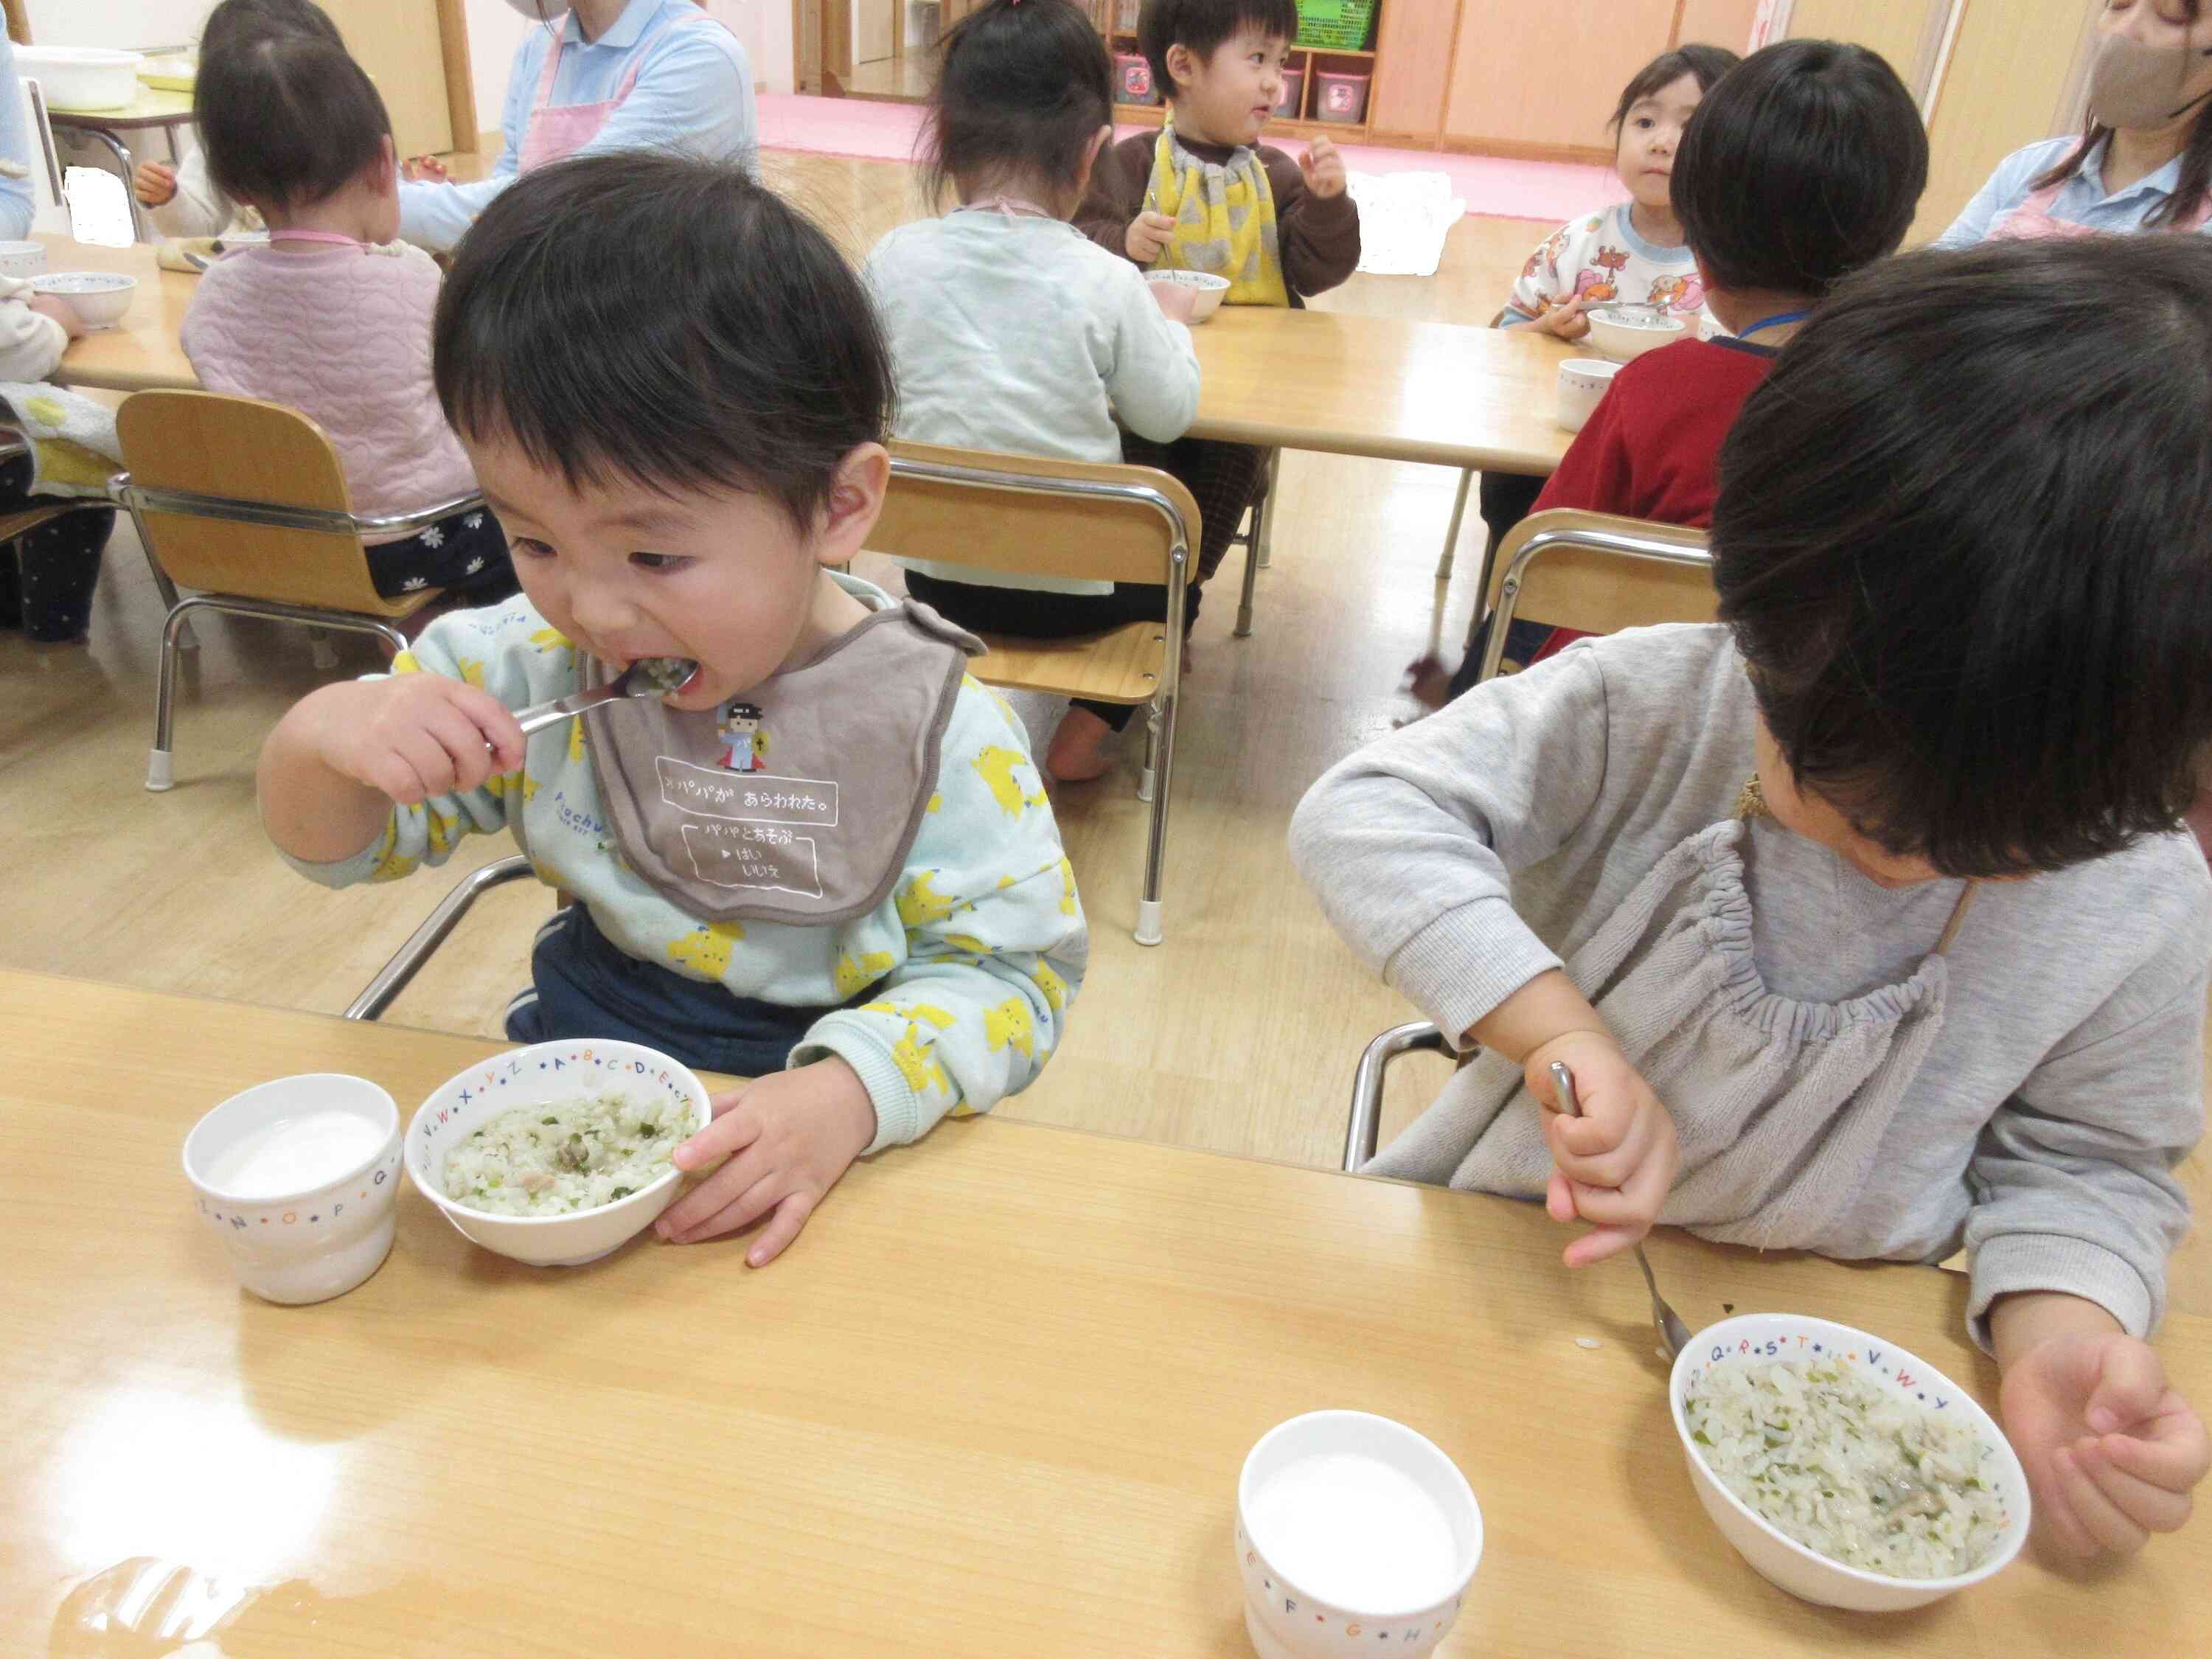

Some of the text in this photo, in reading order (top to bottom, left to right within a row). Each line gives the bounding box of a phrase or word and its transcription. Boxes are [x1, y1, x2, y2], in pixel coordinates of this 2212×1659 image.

[743, 790, 827, 811] あらわれた。
[703, 823, 793, 844] パパとあそぶ
[736, 847, 762, 860] はい
[742, 864, 781, 878] いいえ
[437, 1108, 448, 1124] W
[459, 1088, 473, 1105] X
[635, 1061, 646, 1074] D
[1711, 1346, 1725, 1362] Q
[1738, 1338, 1750, 1354] R
[1765, 1340, 1778, 1355] S
[1796, 1335, 1809, 1349] T
